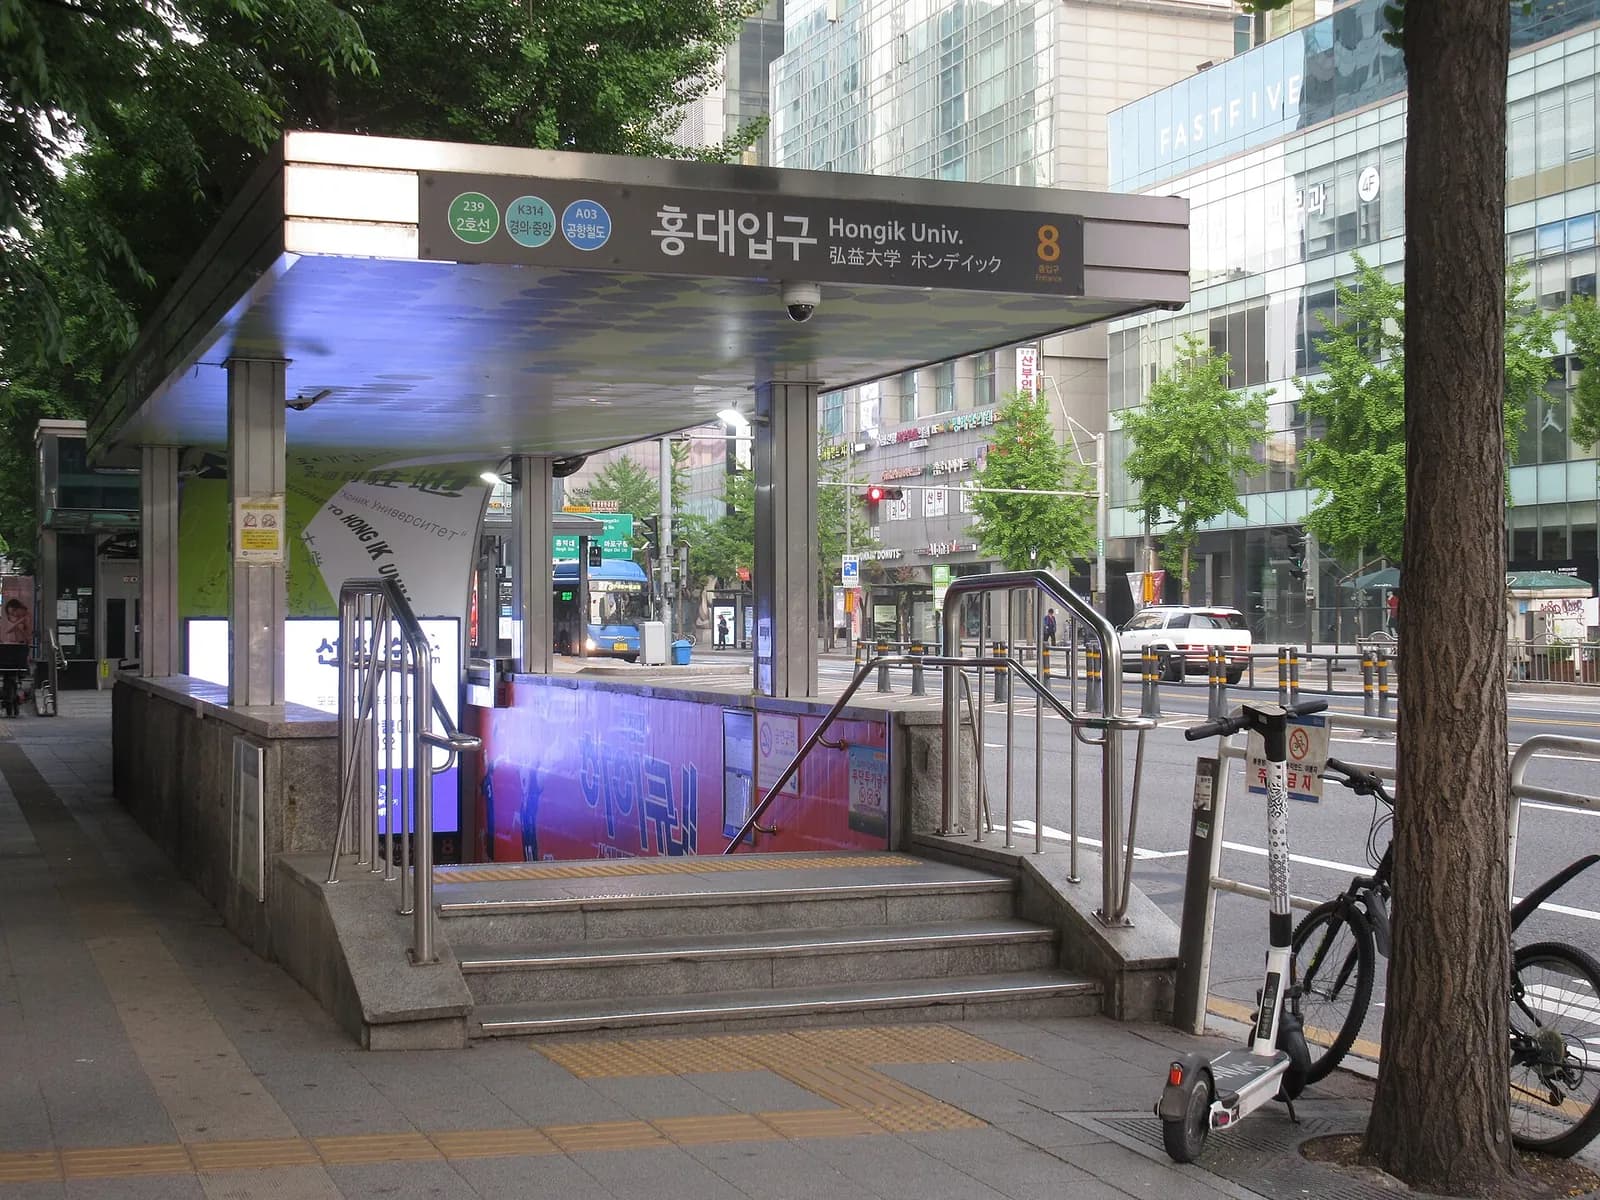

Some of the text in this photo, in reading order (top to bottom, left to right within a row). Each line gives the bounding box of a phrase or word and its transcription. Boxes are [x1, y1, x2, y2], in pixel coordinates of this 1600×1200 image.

[1160, 73, 1301, 155] FASTFIVE
[1361, 173, 1376, 192] 4F
[463, 200, 485, 212] 239
[517, 204, 544, 216] K314
[575, 208, 598, 220] A03
[456, 216, 491, 234] 2호선
[509, 219, 552, 237] 경의·중앙
[566, 222, 606, 239] 공항철도
[650, 204, 818, 261] 홍대입구
[828, 216, 964, 245] Hongik Univ.
[1036, 224, 1061, 262] 8
[829, 245, 902, 267] 弘益大学
[340, 513, 379, 542] HONG
[365, 535, 394, 561] IK
